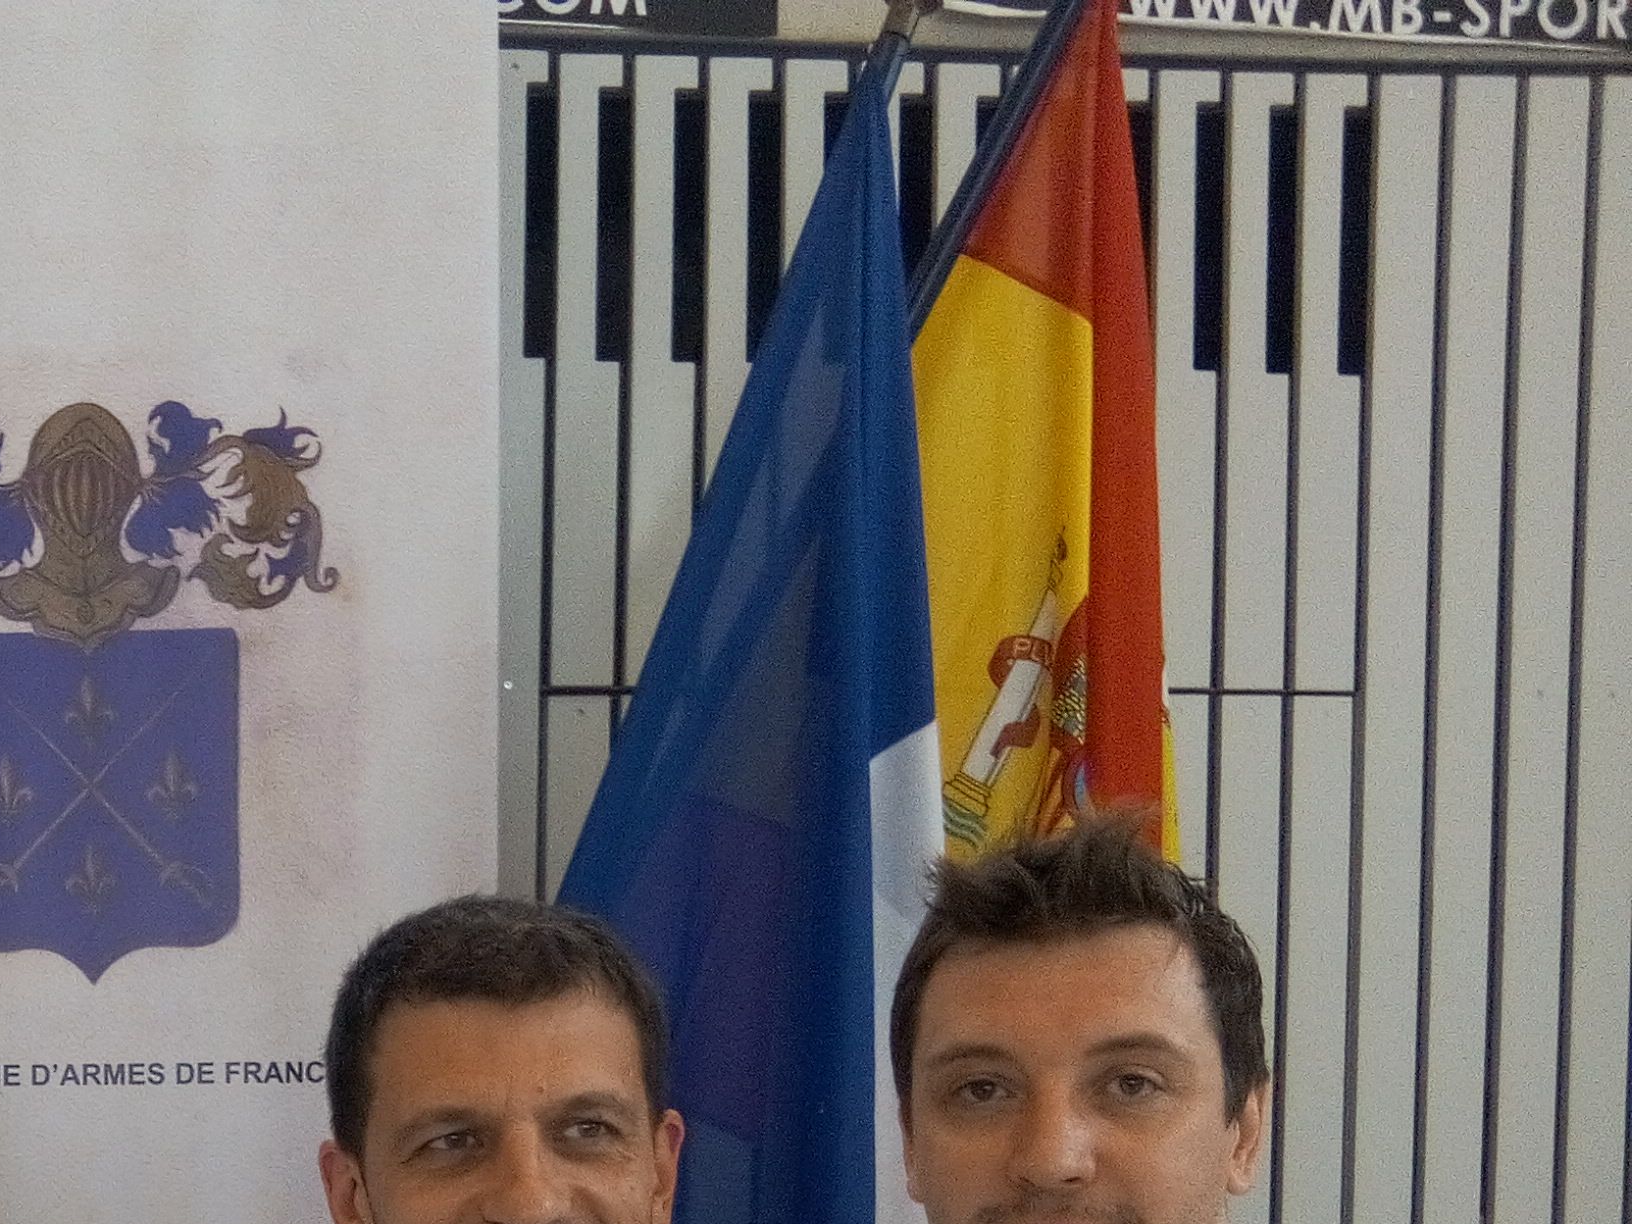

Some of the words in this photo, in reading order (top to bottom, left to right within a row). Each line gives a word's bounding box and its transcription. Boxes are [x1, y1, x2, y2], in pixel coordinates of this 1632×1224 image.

[31, 1063, 165, 1086] D'ARMES
[176, 1062, 214, 1085] DE
[225, 1061, 325, 1084] FRANC
